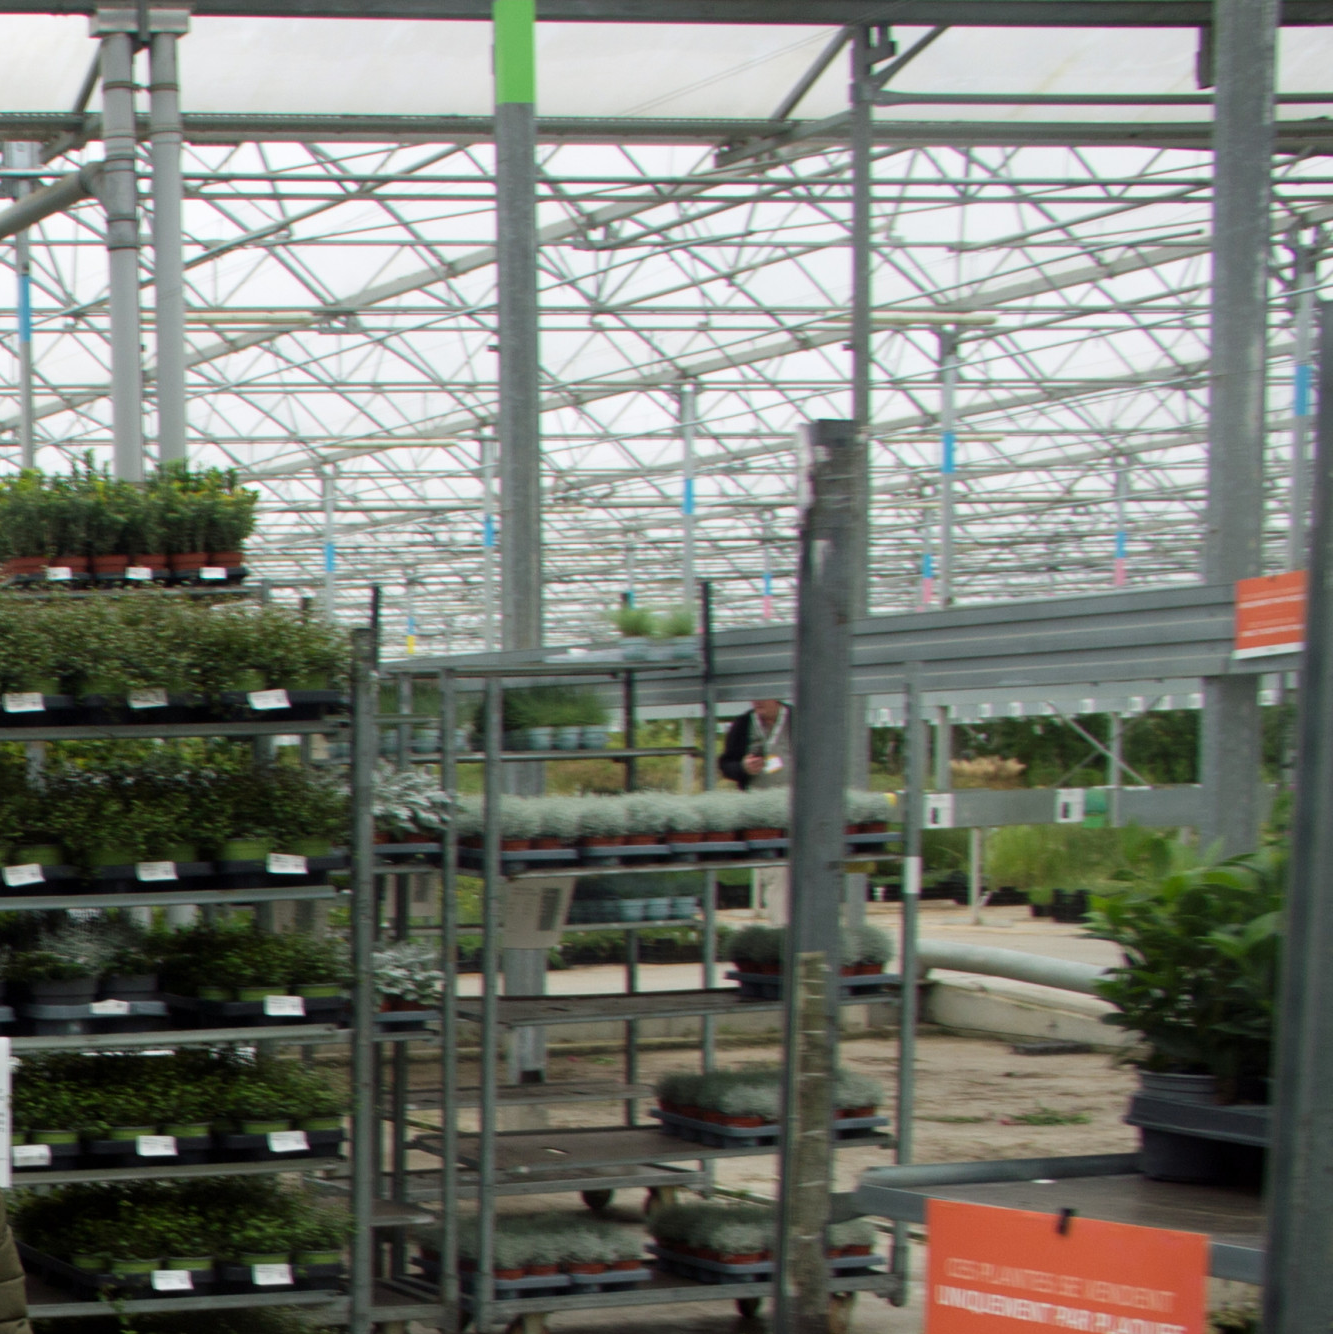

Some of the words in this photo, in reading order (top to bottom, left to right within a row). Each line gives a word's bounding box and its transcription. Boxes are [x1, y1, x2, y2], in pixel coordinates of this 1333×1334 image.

[935, 1284, 1054, 1324] UNIQUEMENT
[1055, 1306, 1096, 1333] PAR
[979, 1262, 1055, 1294] PLANTES
[1057, 1274, 1082, 1298] SE
[1083, 1278, 1176, 1313] VENDENT
